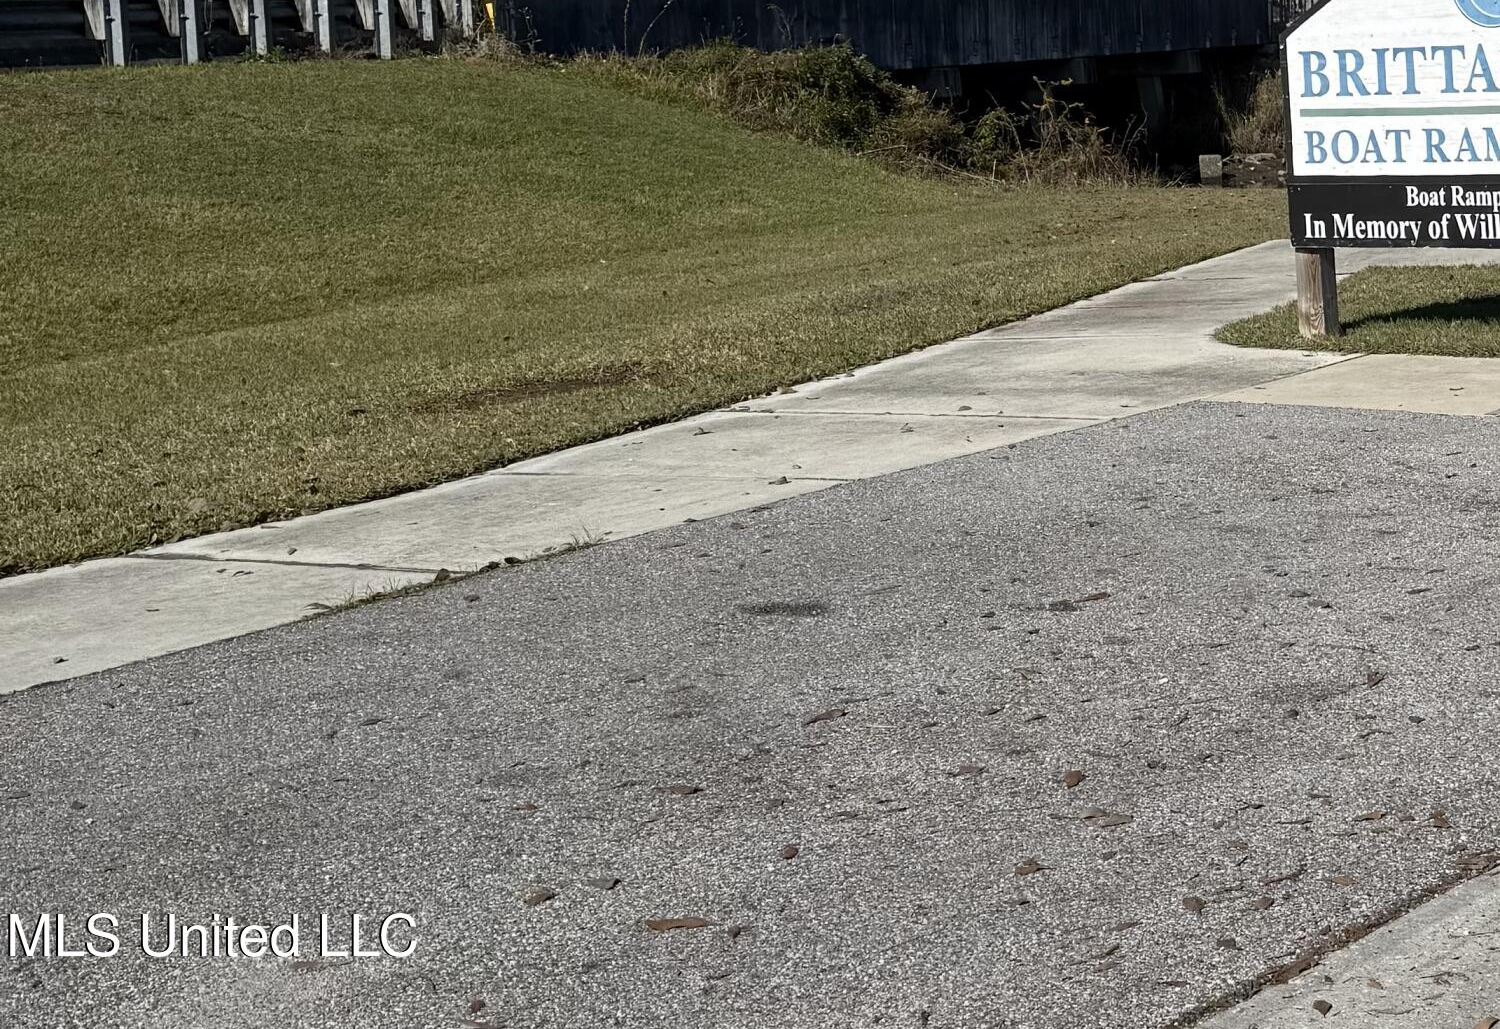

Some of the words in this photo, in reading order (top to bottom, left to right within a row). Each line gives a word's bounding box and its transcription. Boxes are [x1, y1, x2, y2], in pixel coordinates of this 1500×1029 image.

[1304, 129, 1411, 164] BOAT
[1406, 186, 1445, 208] Boat
[1304, 214, 1326, 240] In
[1332, 215, 1422, 245] Memory
[1428, 213, 1452, 239] of
